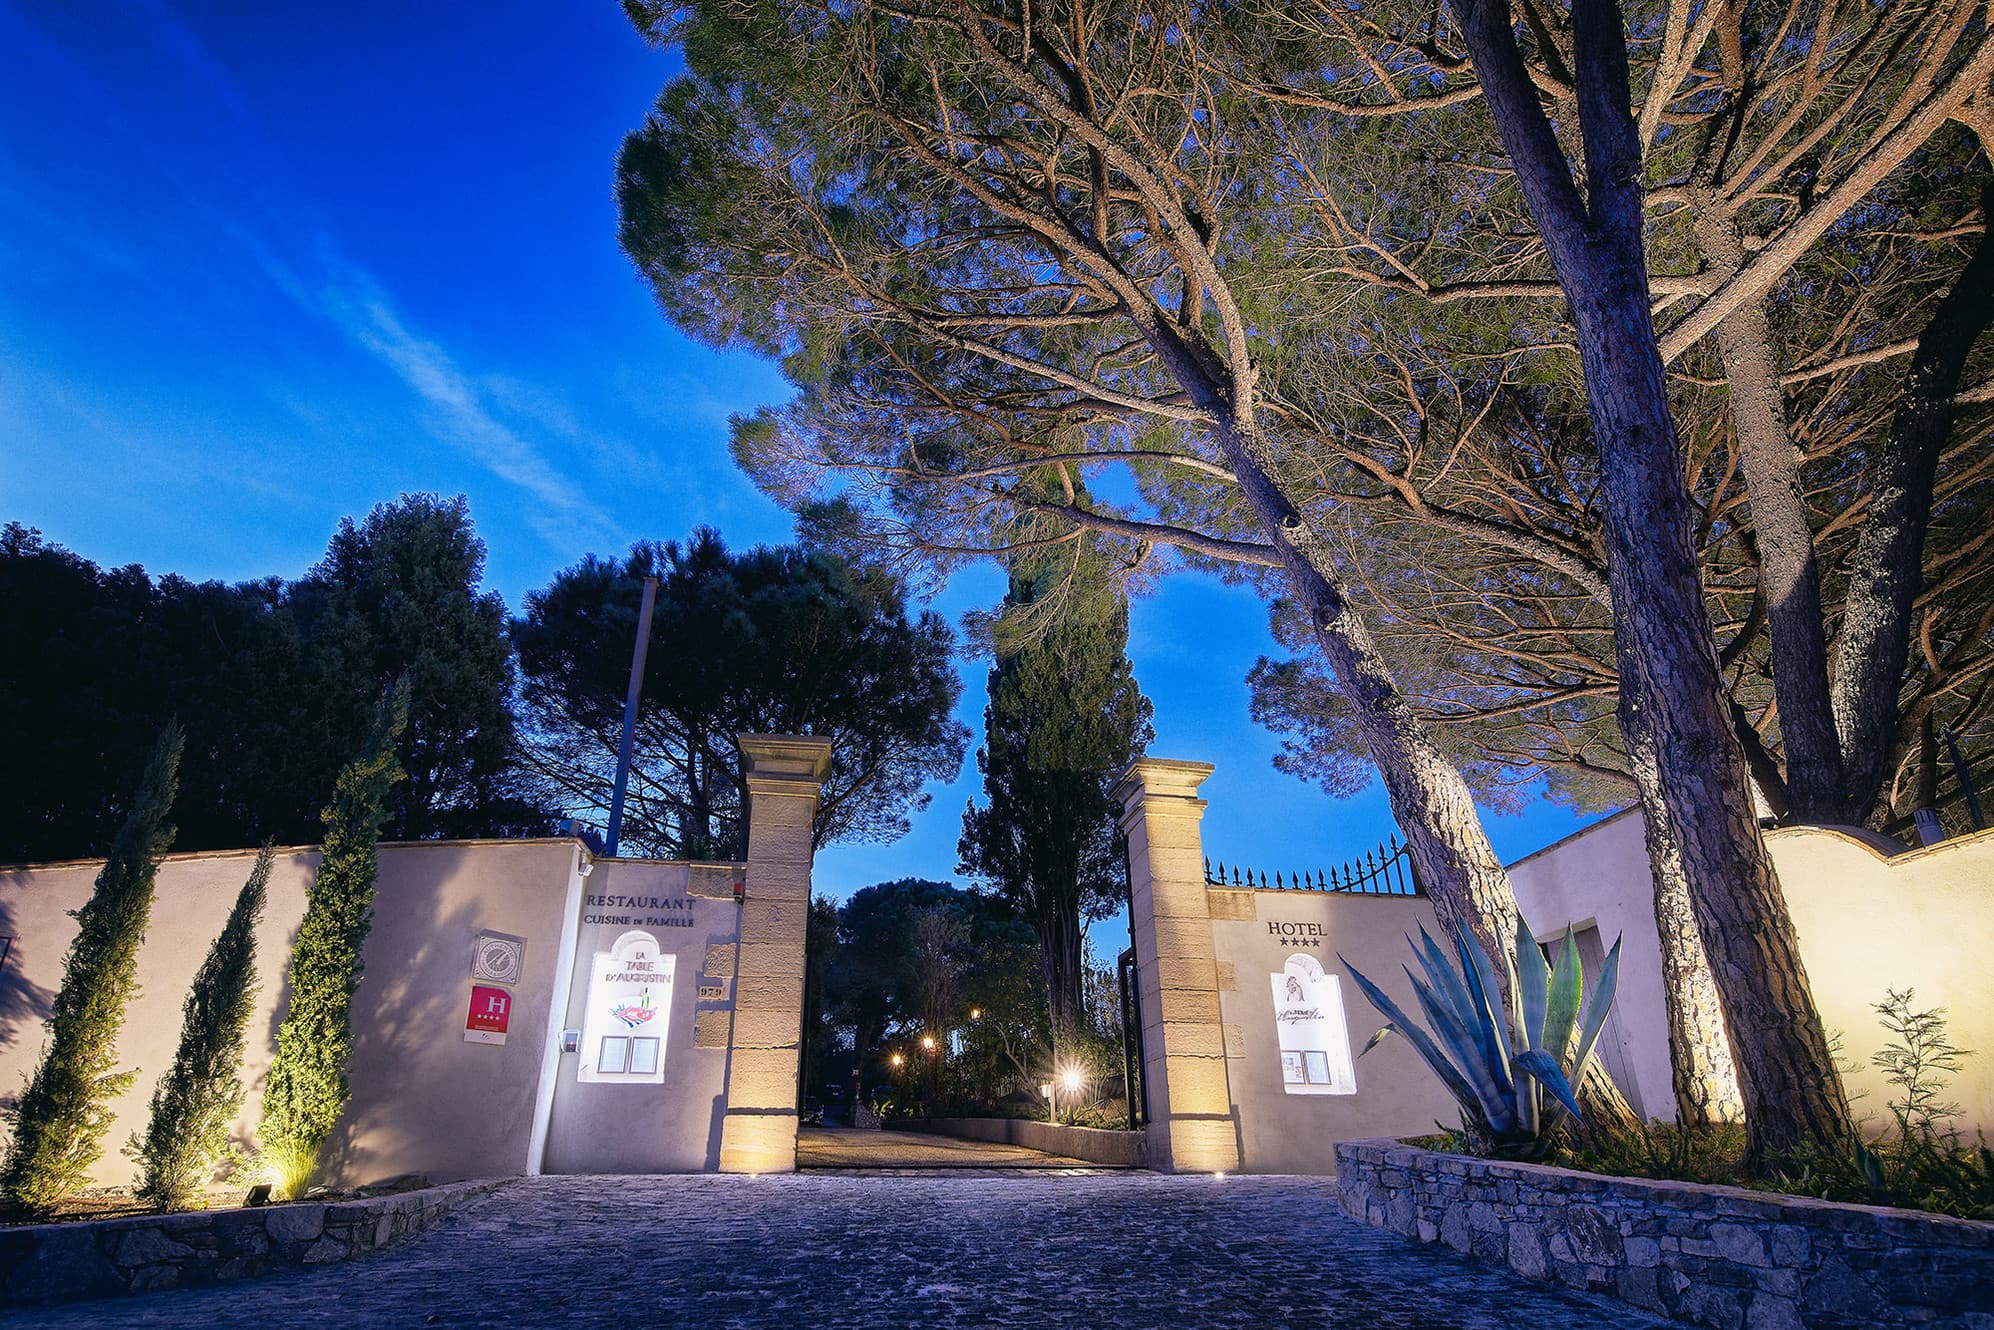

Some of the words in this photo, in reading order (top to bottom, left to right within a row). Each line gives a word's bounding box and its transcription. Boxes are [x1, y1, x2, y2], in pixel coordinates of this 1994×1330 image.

[586, 895, 697, 910] RESTAURANT
[584, 914, 631, 925] CUISINE
[646, 917, 695, 928] FAMILLE
[1267, 921, 1329, 937] HOTEL
[635, 951, 647, 960] LA
[626, 960, 655, 972] TABLE
[604, 973, 672, 984] D'AUGUSTIN
[700, 987, 722, 997] 979
[487, 996, 506, 1014] H
